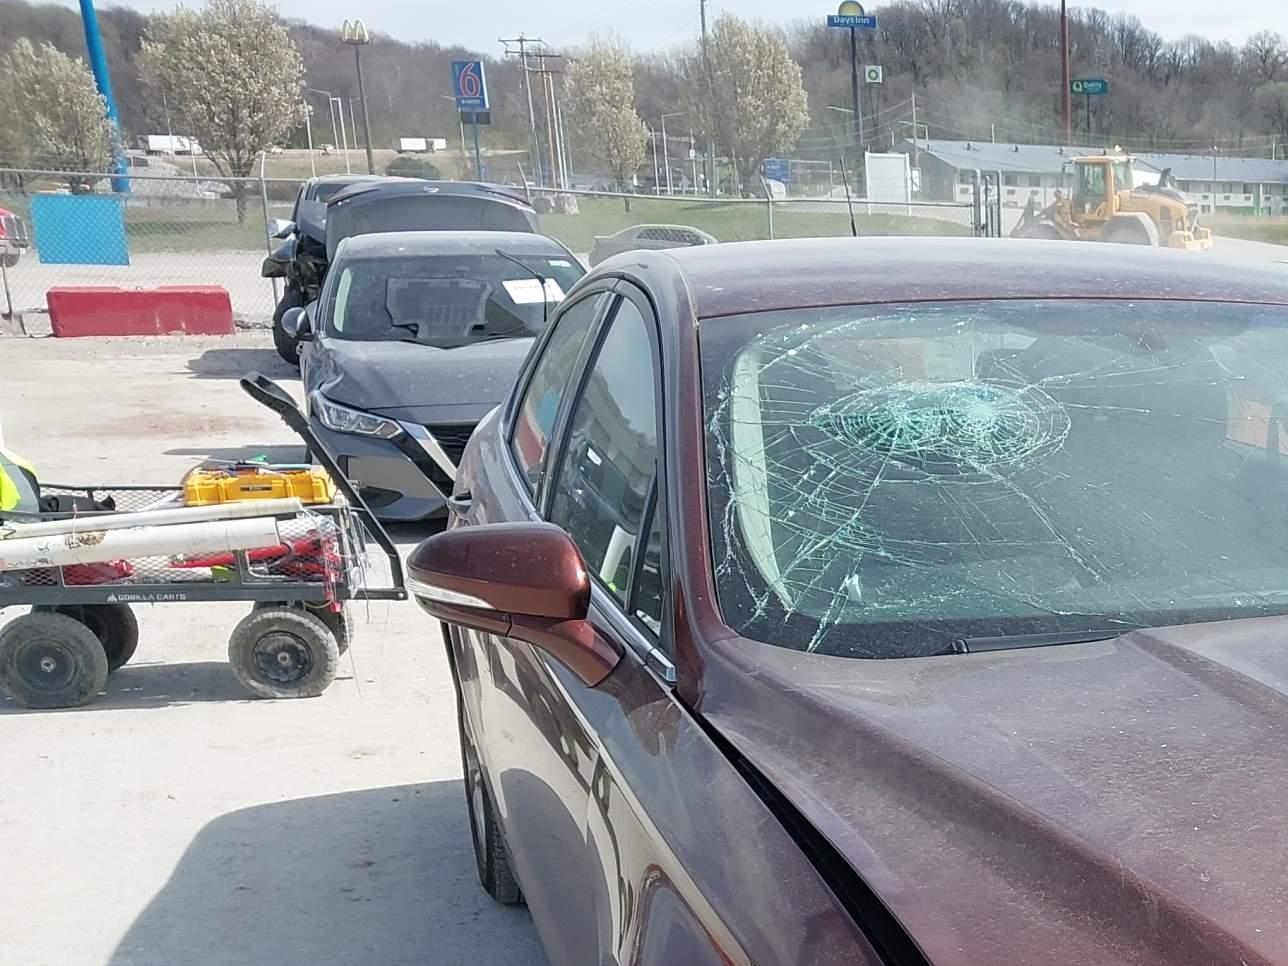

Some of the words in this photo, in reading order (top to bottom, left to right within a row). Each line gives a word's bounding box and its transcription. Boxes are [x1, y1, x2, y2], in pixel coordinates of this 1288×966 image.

[833, 16, 855, 25] Days
[855, 16, 870, 24] Inn
[459, 62, 481, 97] 6
[118, 593, 155, 601] GORILLA
